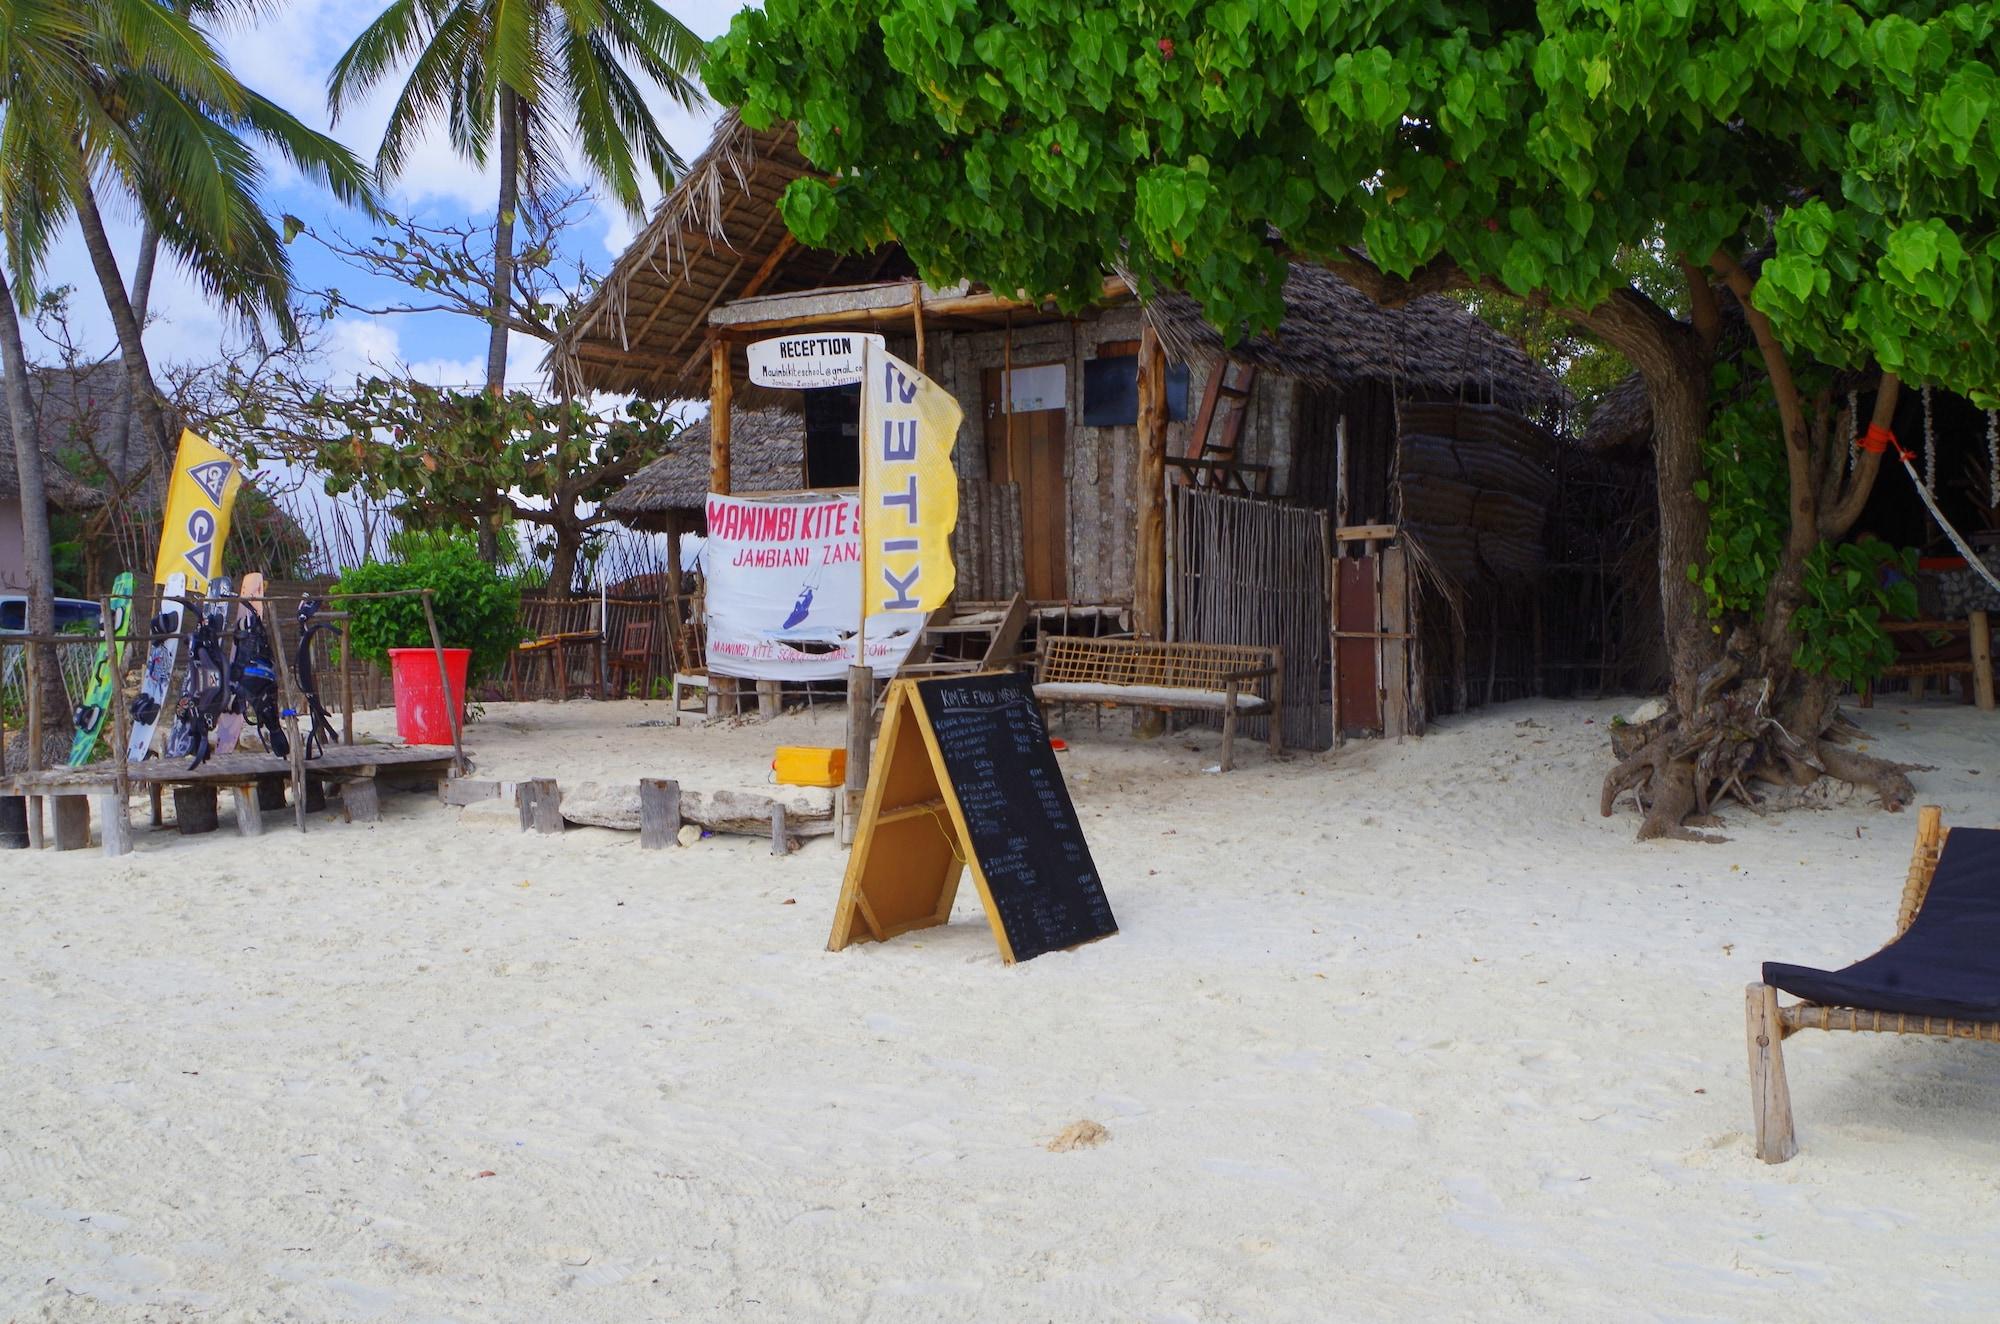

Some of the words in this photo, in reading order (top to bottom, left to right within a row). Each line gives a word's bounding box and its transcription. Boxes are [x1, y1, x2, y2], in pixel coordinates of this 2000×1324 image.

[780, 337, 852, 358] RECEPTION
[708, 501, 797, 542] MAWIMBI
[801, 502, 848, 540] KITE
[733, 547, 809, 568] JAMBIANI
[713, 641, 749, 656] MAWIMBI
